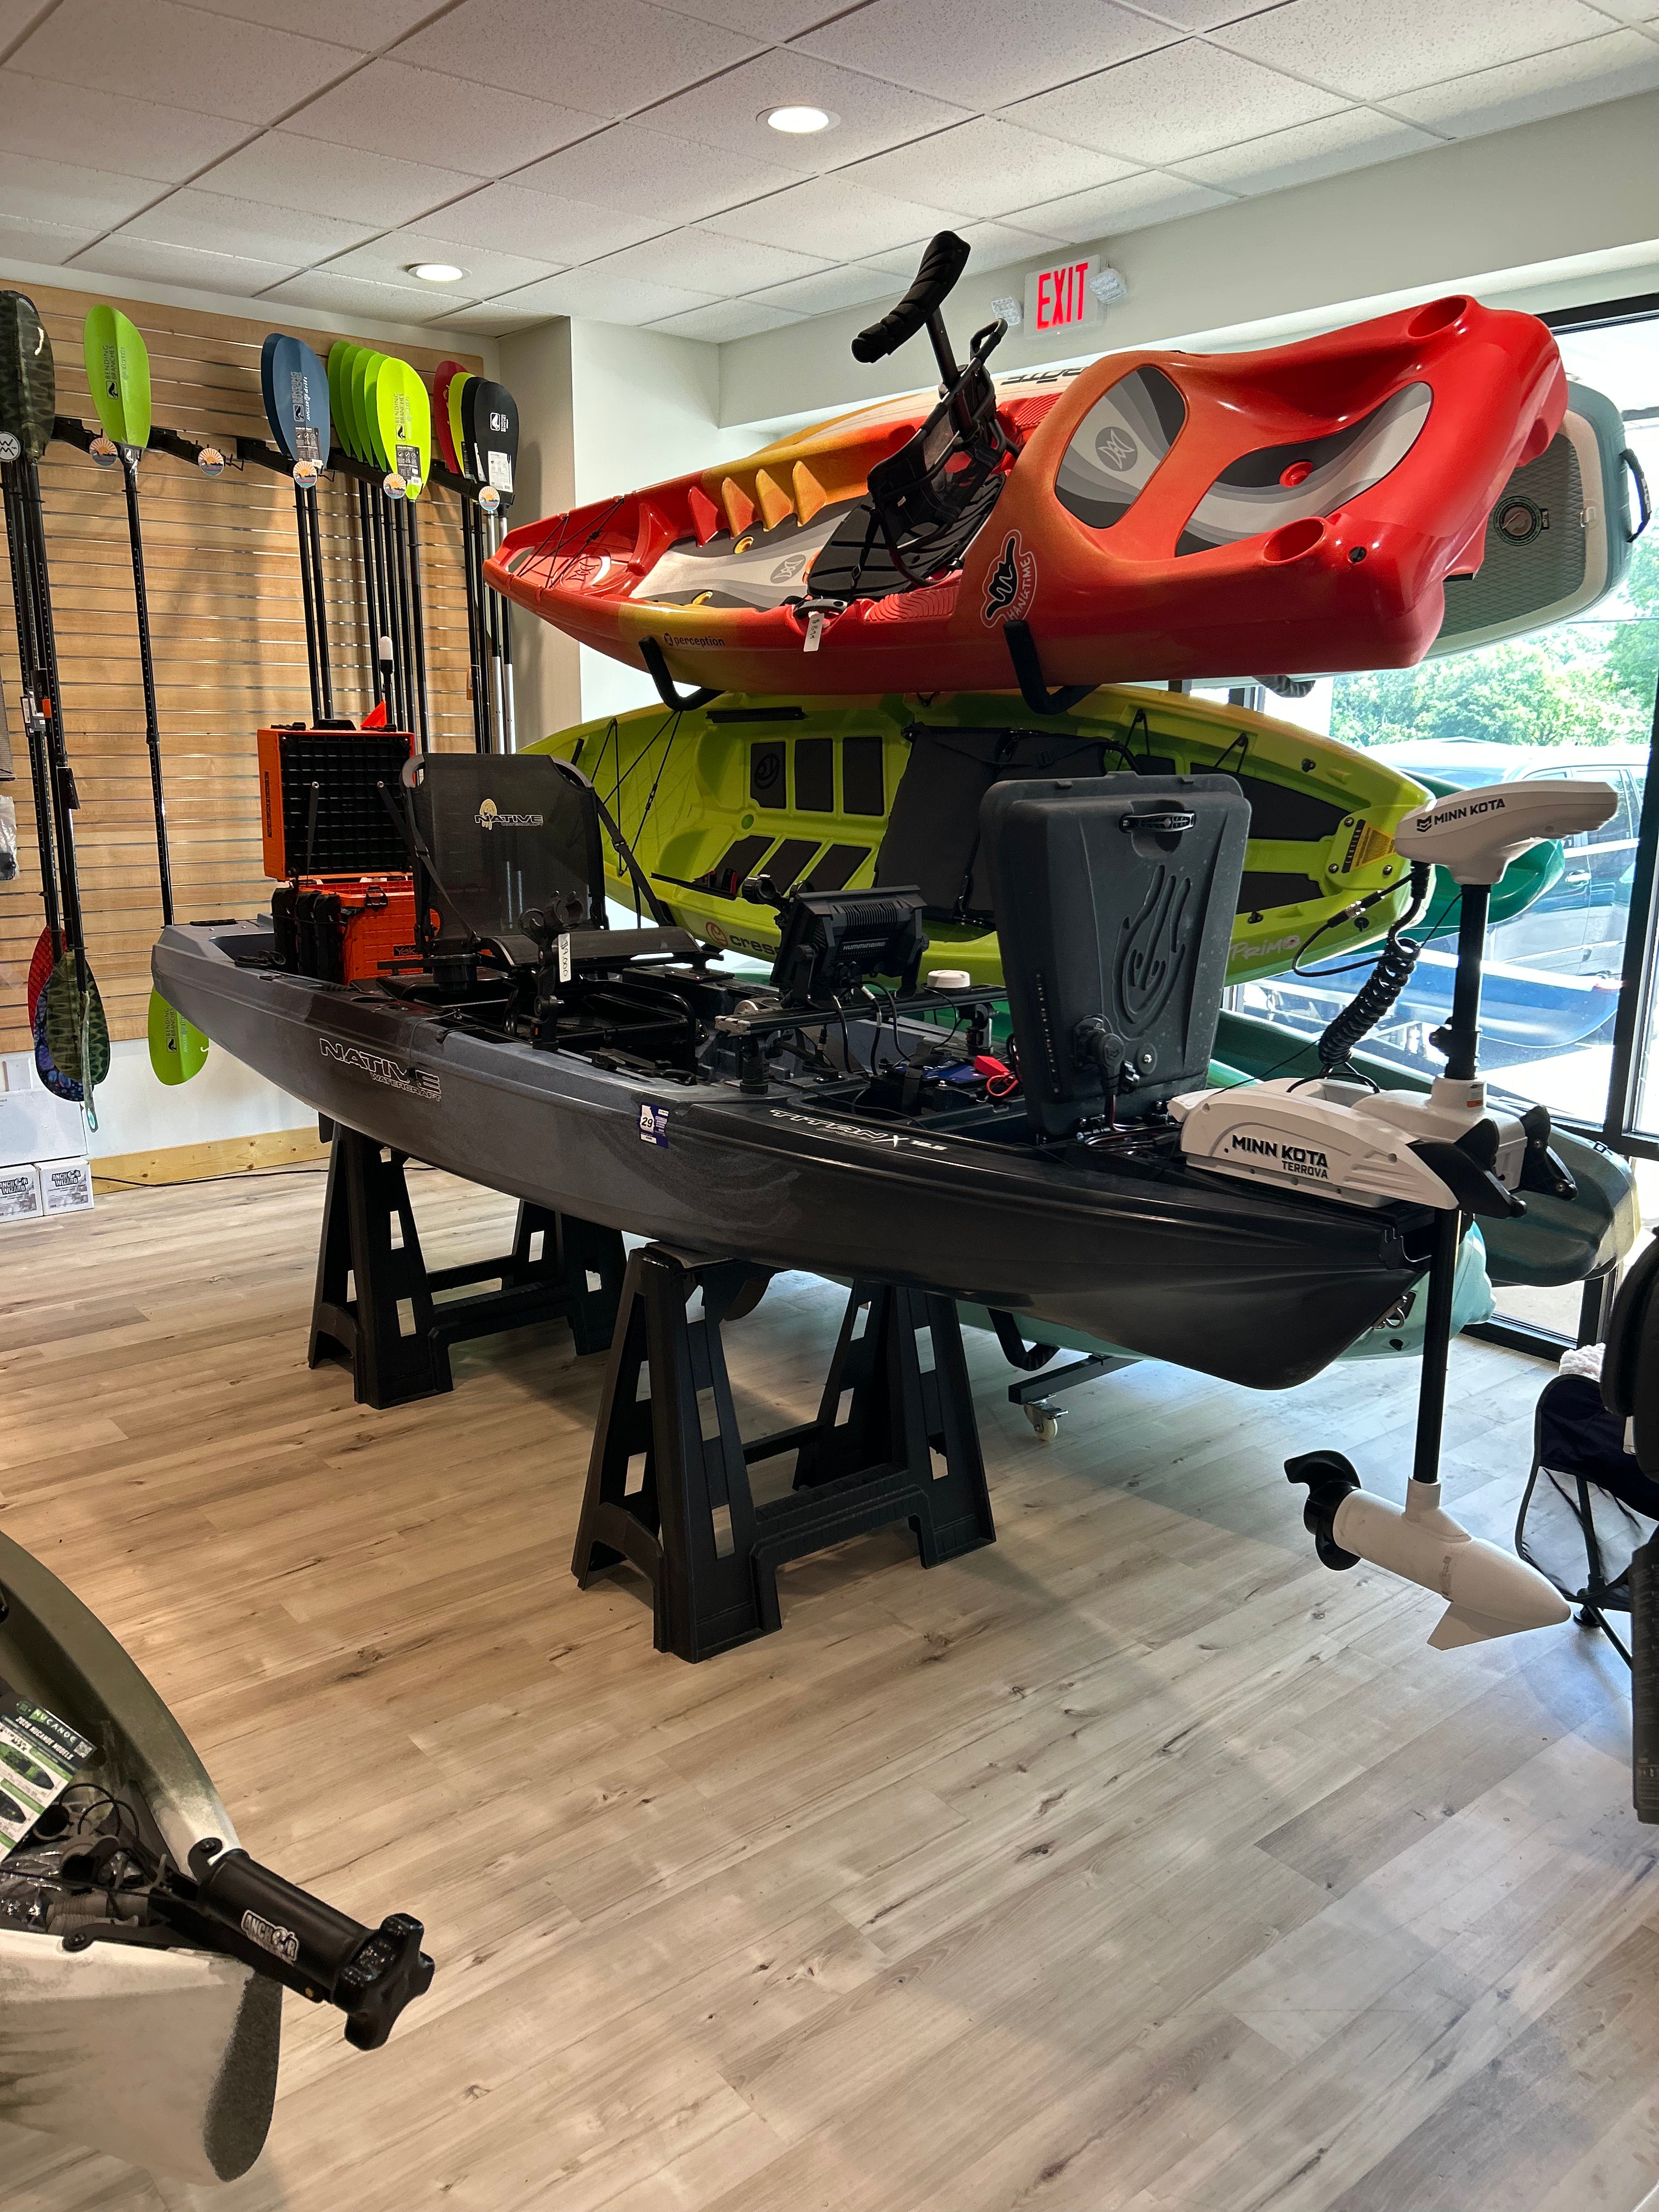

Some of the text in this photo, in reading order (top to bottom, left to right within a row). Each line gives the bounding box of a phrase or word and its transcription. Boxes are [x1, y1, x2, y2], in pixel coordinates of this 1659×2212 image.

[1036, 262, 1088, 330] EXIT
[103, 345, 111, 380] BENDING
[674, 635, 725, 648] perception
[474, 815, 543, 823] NATIVE
[1434, 798, 1505, 825] MINN KOTA
[1345, 829, 1362, 864] CAUTION
[843, 942, 886, 950] HUMMINBIRD
[319, 1038, 441, 1094] NATIVE
[369, 1071, 442, 1102] WATERCRAFT
[641, 1117, 653, 1128] 29
[769, 1109, 889, 1139] TITAN
[1232, 1135, 1328, 1168] MINN KOTA
[55, 1178, 78, 1187] WIZARD
[1282, 1160, 1328, 1179] TERROVA
[2, 1185, 26, 1194] WIZARD
[33, 1709, 78, 1743] NUCANOE
[29, 1726, 54, 1746] NUCANOE
[52, 1742, 74, 1760] MODELS
